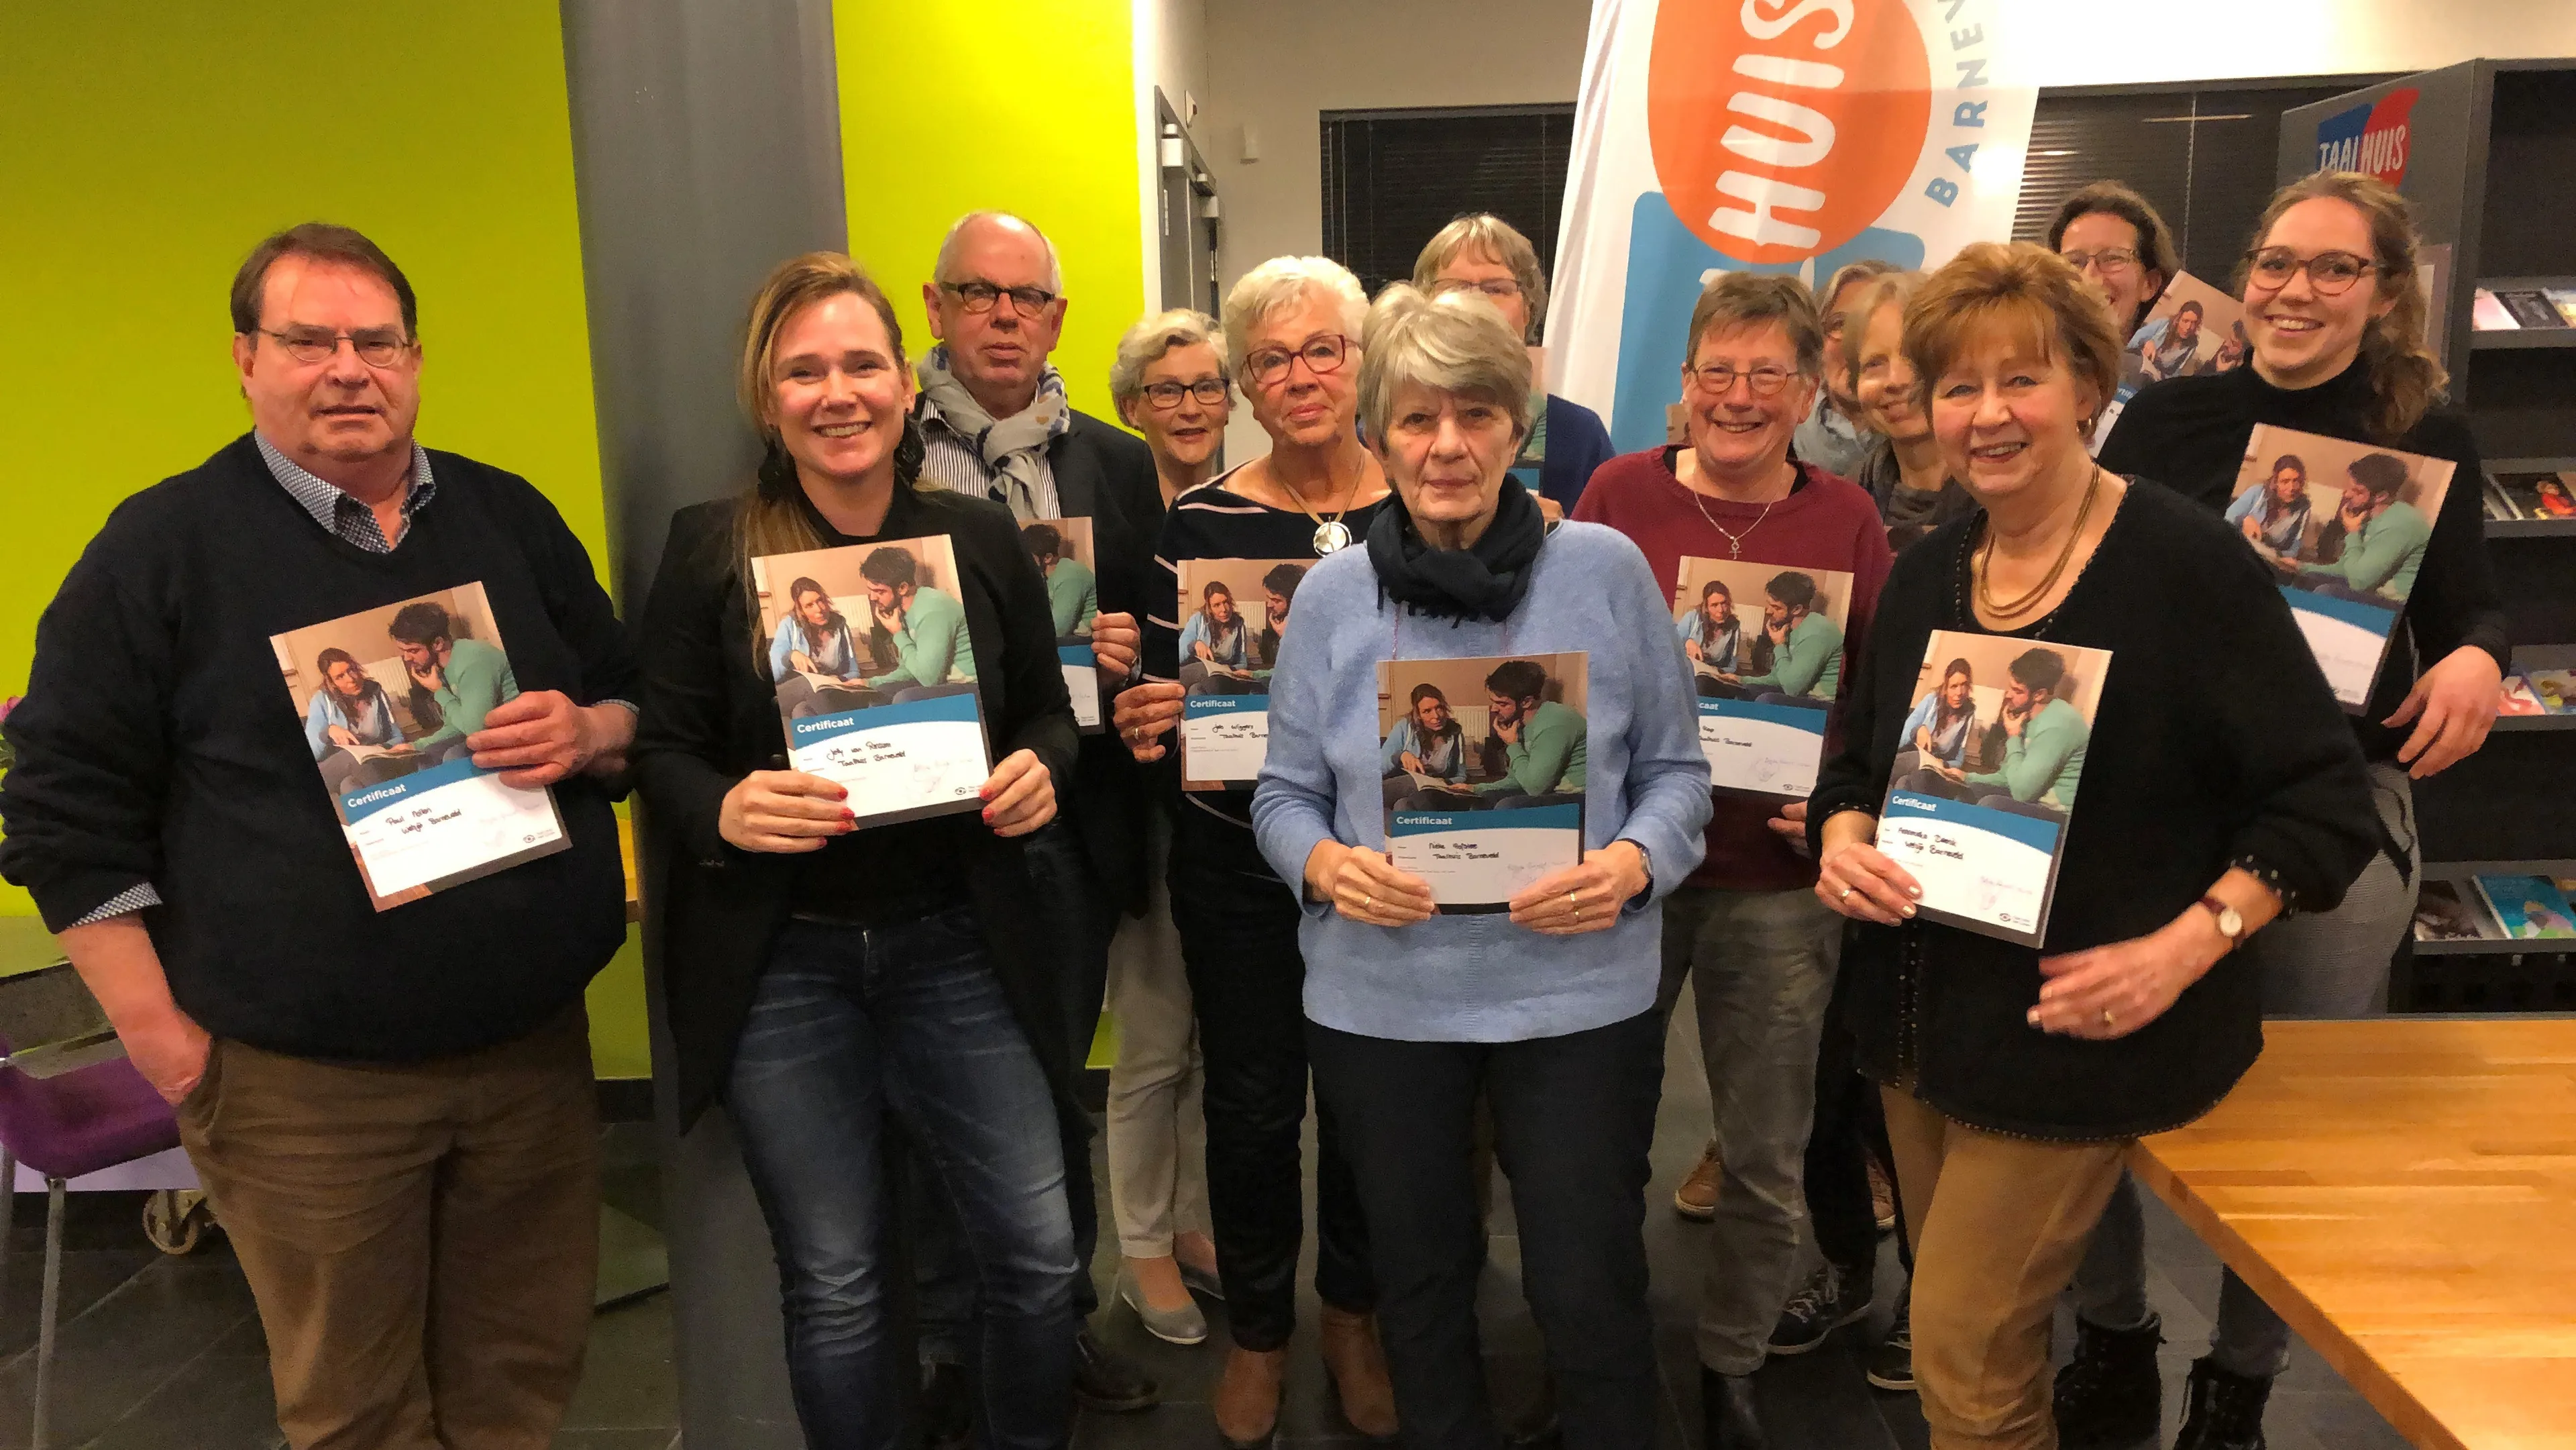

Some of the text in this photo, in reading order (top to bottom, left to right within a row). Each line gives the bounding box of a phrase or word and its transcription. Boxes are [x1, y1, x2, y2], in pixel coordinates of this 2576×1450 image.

[1708, 0, 1854, 249] HUIS
[1189, 700, 1236, 708] Certificaat
[796, 717, 855, 733] Certificaat
[347, 783, 407, 808] Certificaat
[1892, 795, 1937, 812] Certificaat
[1396, 816, 1452, 825] Certificaat
